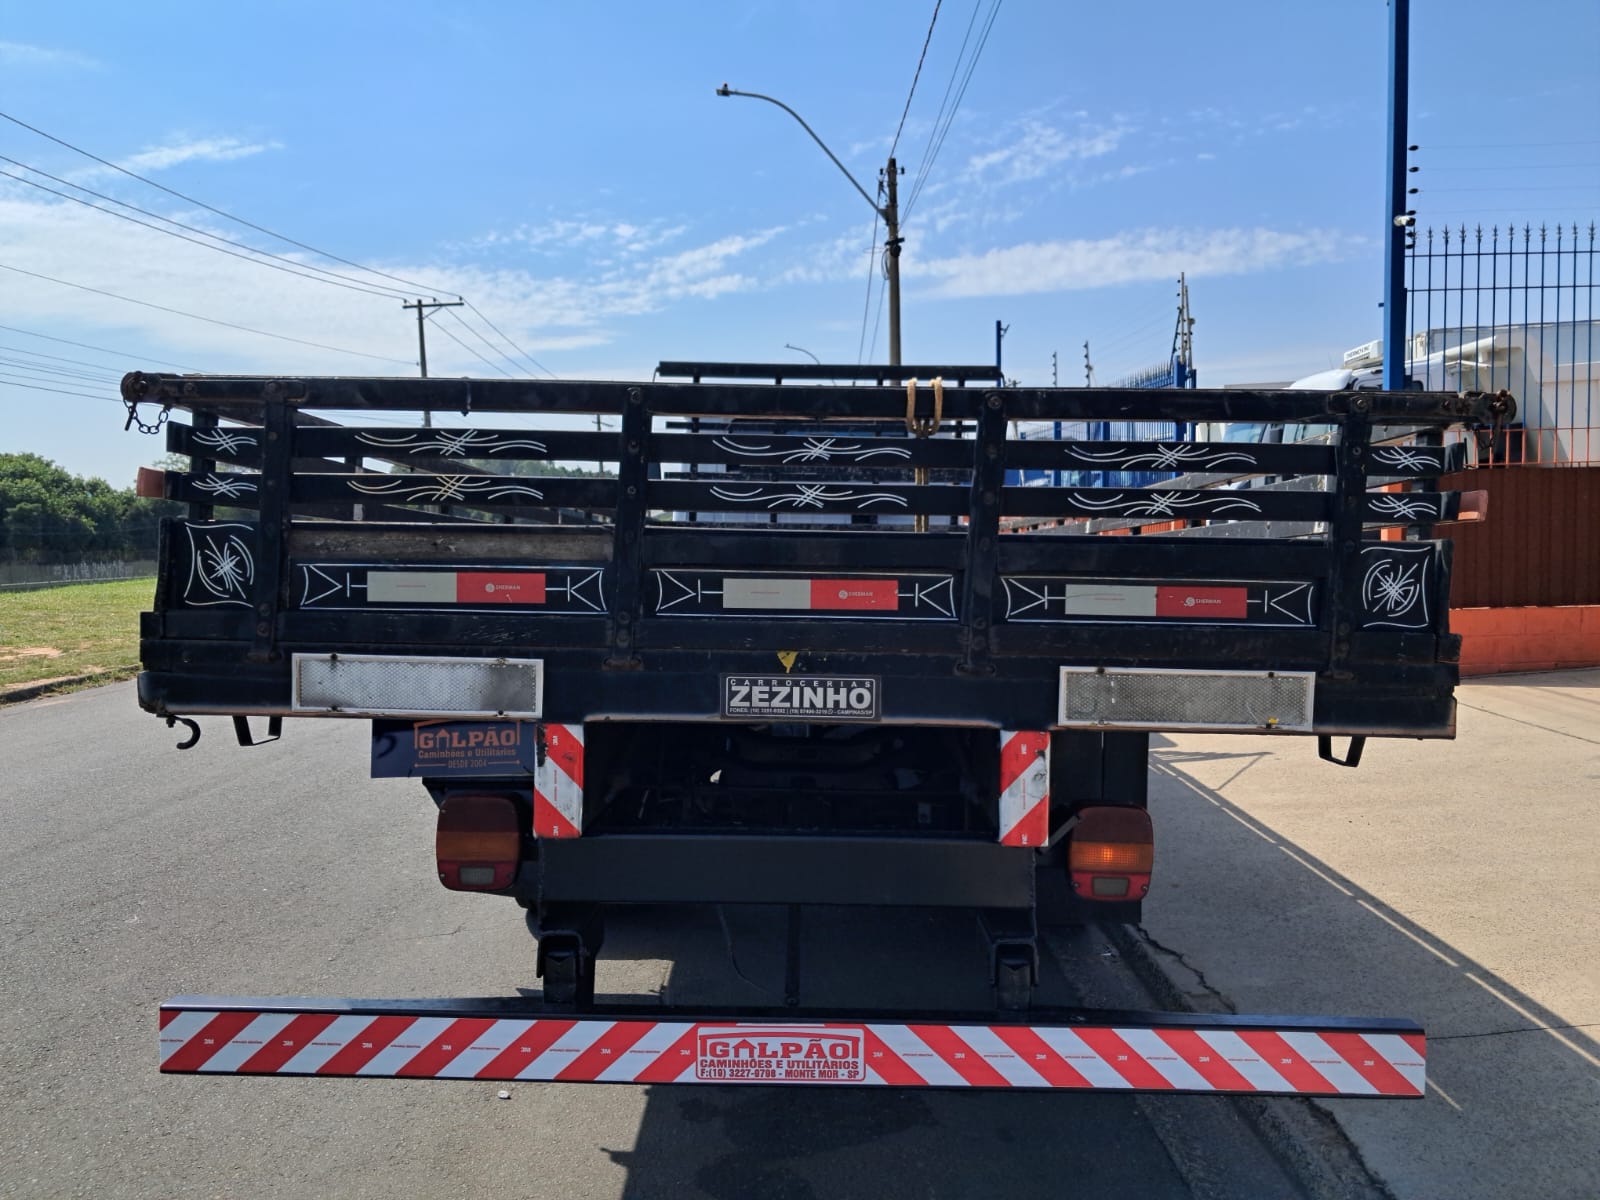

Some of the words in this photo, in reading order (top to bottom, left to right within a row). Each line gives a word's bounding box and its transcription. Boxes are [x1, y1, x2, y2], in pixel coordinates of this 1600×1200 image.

[730, 679, 871, 688] CARROCERIAS
[729, 686, 872, 709] ZEZINHO
[418, 749, 465, 759] Caminhões
[447, 759, 468, 769] DESDE
[700, 1058, 773, 1069] CAMINHÕES
[775, 1059, 783, 1069] E
[787, 1058, 859, 1070] UTILITÁRIOS
[784, 1069, 816, 1079] MONTE
[818, 1070, 839, 1079] MOR
[847, 1070, 859, 1079] SP
